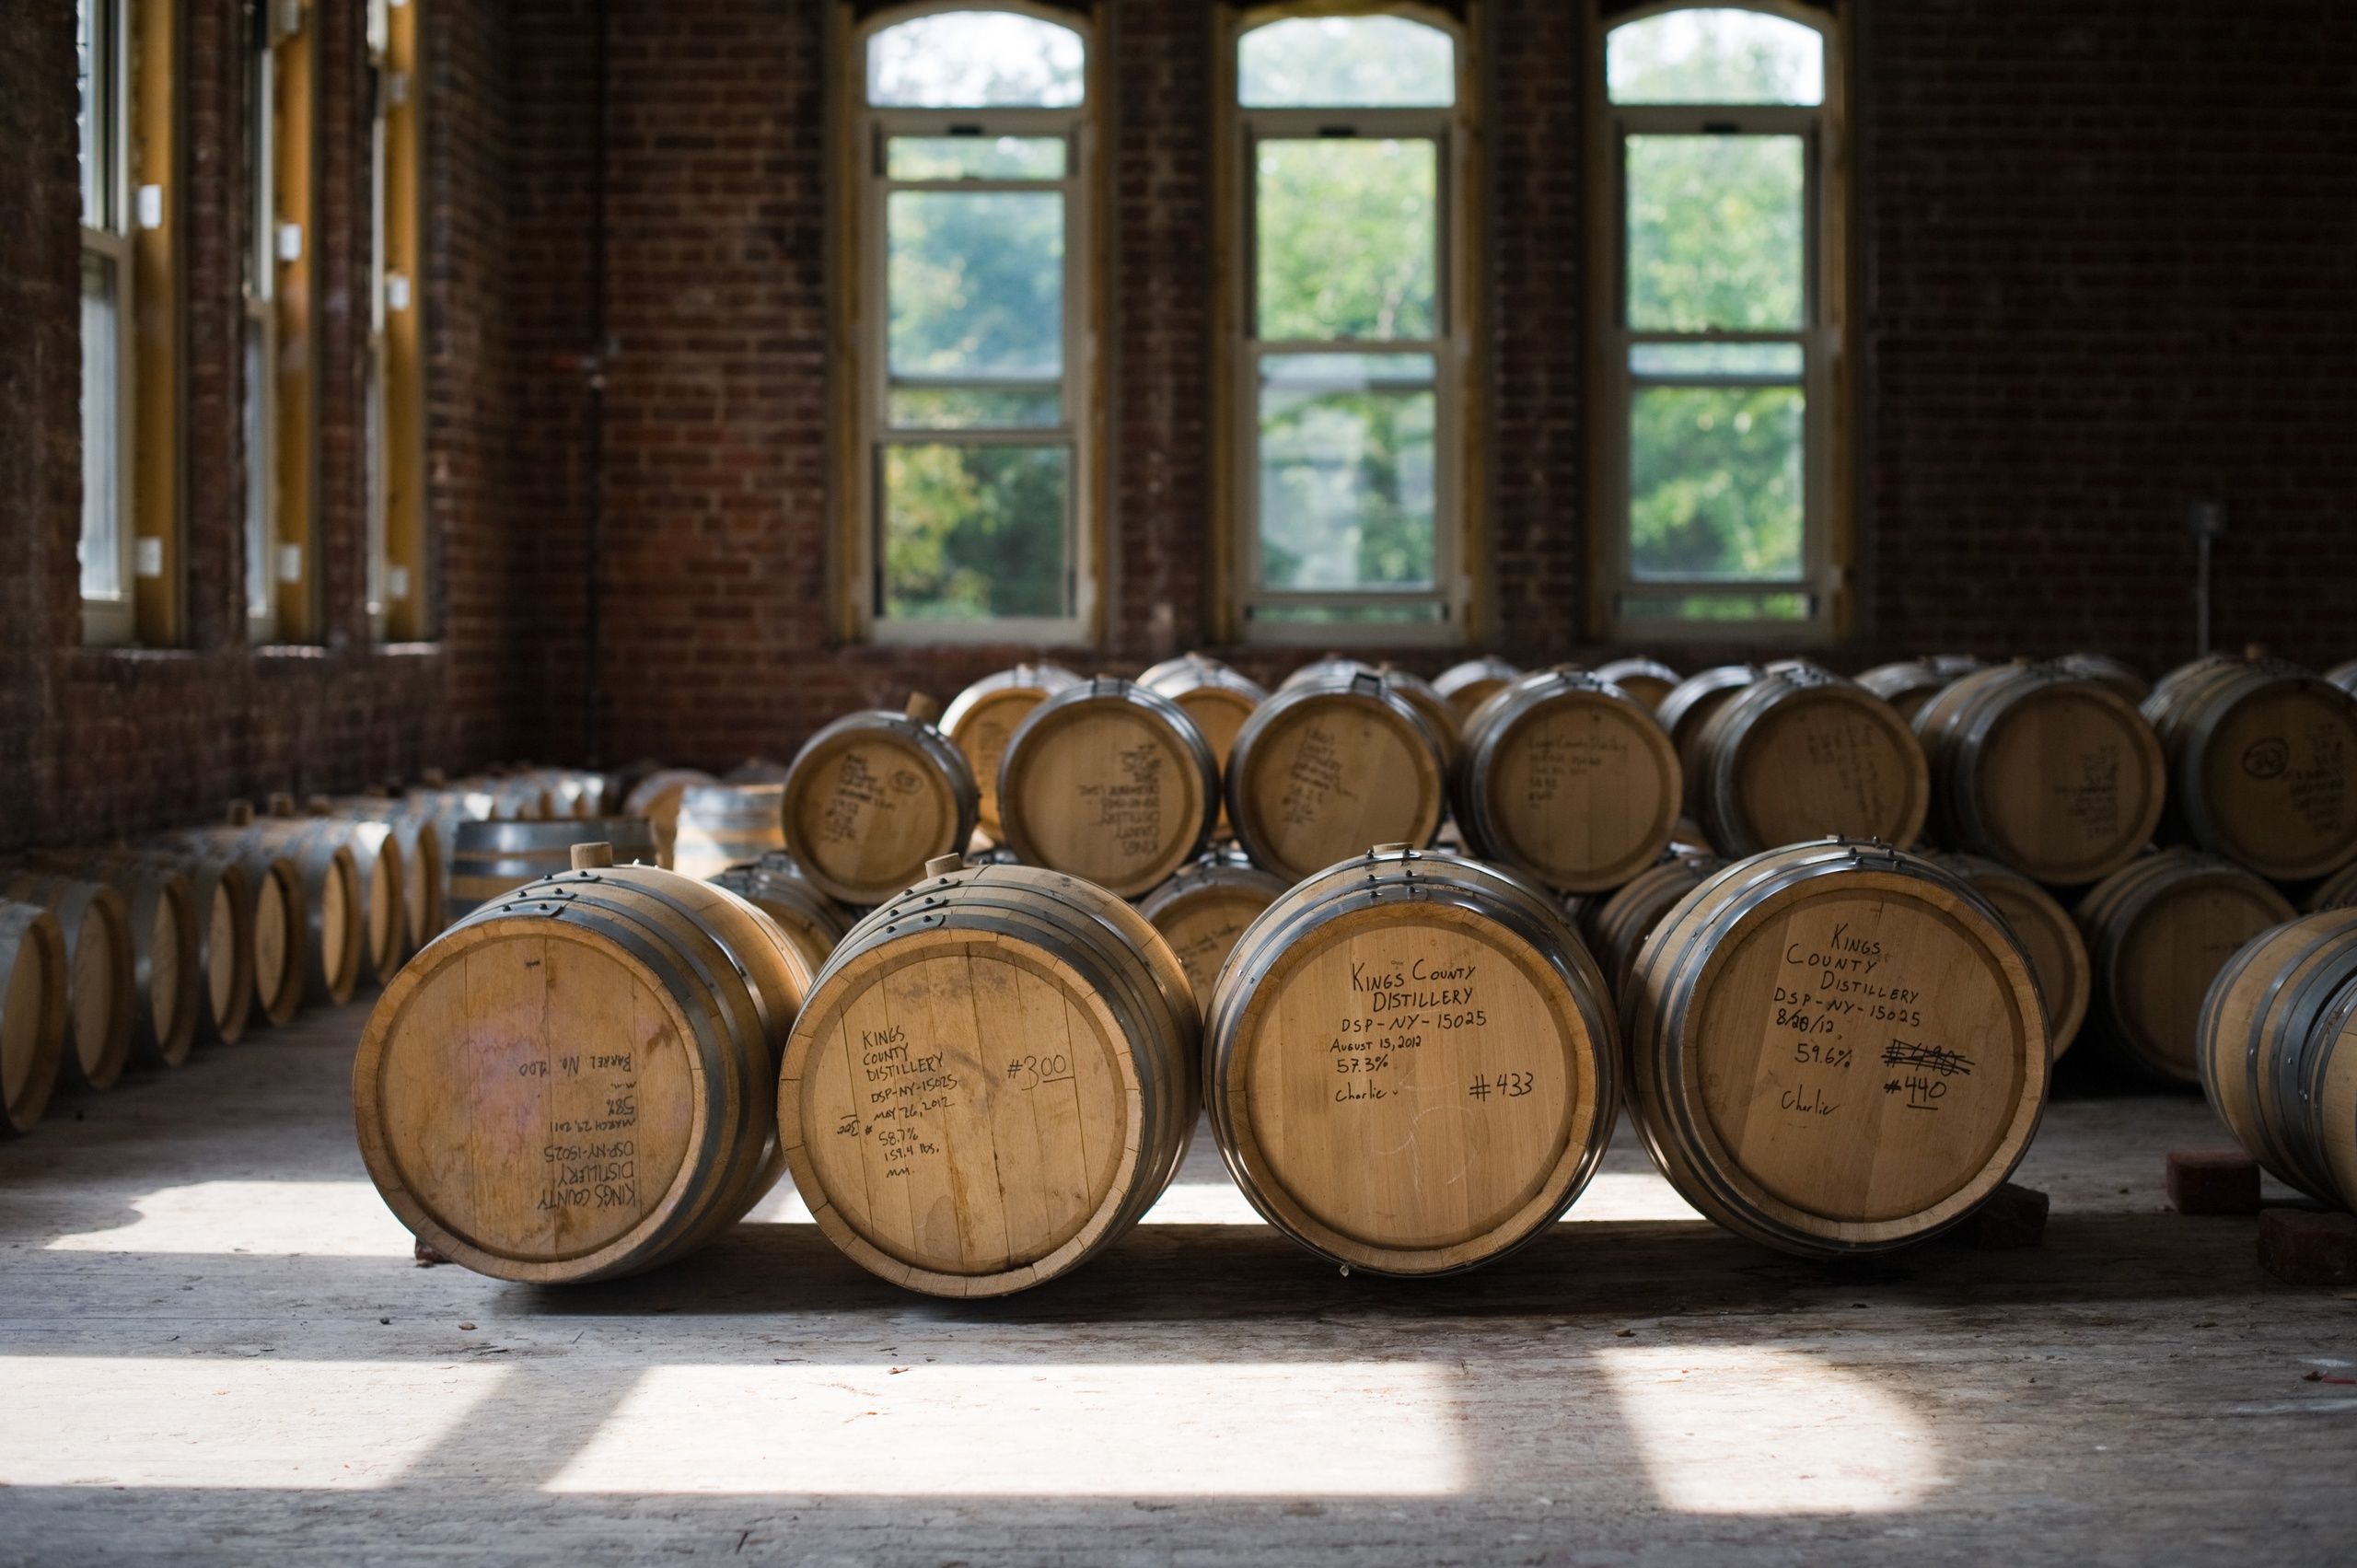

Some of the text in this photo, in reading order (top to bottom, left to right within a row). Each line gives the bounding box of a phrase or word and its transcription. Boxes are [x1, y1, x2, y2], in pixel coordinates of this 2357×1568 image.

[1831, 923, 1880, 955] KINGS
[1786, 943, 1877, 974] COUNTY
[1353, 962, 1405, 993] KINGS
[1412, 958, 1476, 981] COUNTY
[1821, 970, 1919, 1005] DISTILLERY
[1373, 987, 1473, 1013] DISTILLERY
[863, 1025, 906, 1050] KINGS
[1329, 1038, 1374, 1053] AUGUST
[591, 1052, 632, 1072] BARREL
[863, 1042, 908, 1065] COUNTY
[1337, 1053, 1388, 1074] 57.3%
[1795, 1043, 1852, 1069] 59.6%
[866, 1052, 944, 1082] DISTILLERY
[1007, 1055, 1067, 1091] #300
[606, 1096, 635, 1116] 58%
[874, 1108, 896, 1121] MAY
[595, 1118, 635, 1131] MARCH
[878, 1127, 919, 1146] 58.7%
[884, 1145, 913, 1162] 159.4
[558, 1161, 634, 1188] DISTILLERY
[538, 1180, 635, 1210] KINGS COUNTY
